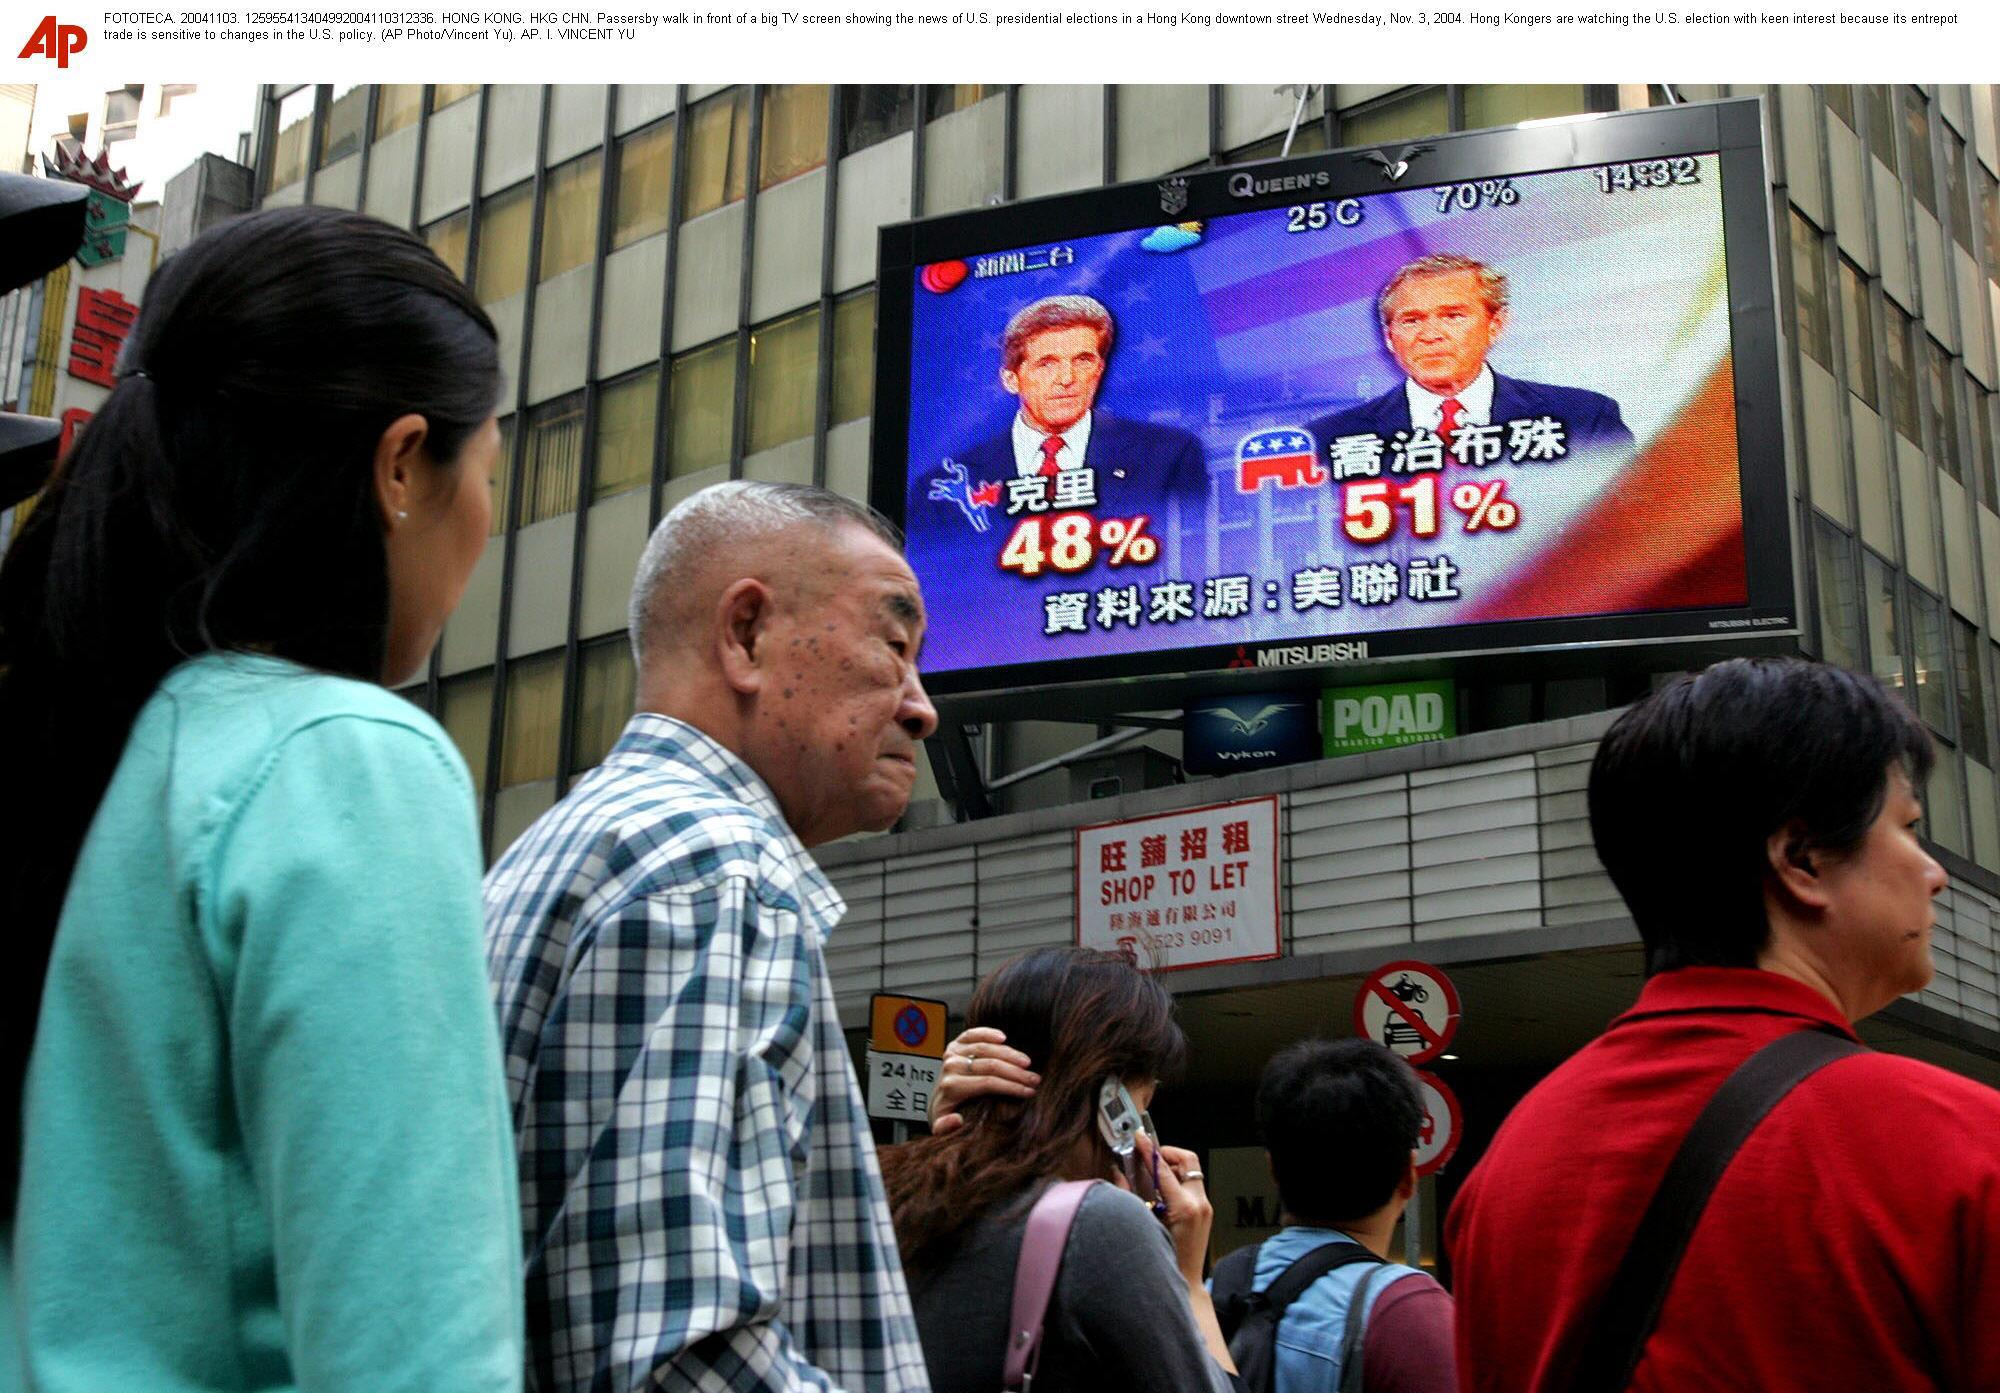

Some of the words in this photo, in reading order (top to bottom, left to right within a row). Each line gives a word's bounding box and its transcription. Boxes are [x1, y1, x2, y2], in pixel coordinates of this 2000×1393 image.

[1594, 156, 1699, 192] 14:32
[1435, 179, 1516, 212] 70%
[1287, 203, 1328, 232] 25
[1335, 199, 1361, 225] C
[1330, 416, 1567, 480] 喬治布殊
[1006, 467, 1098, 515] 克里
[1344, 474, 1518, 542] 51%
[1000, 514, 1157, 574] 48%
[1256, 640, 1369, 668] MITSUBISHI
[1333, 692, 1445, 739] POAD
[1216, 749, 1277, 761] Vykon
[1101, 874, 1155, 906] SHOP
[1168, 869, 1196, 896] TO
[1210, 861, 1249, 890] LET
[1190, 927, 1232, 948] 9091
[881, 1062, 906, 1078] 24
[910, 1065, 935, 1083] hrs
[885, 1087, 928, 1113] 全日
